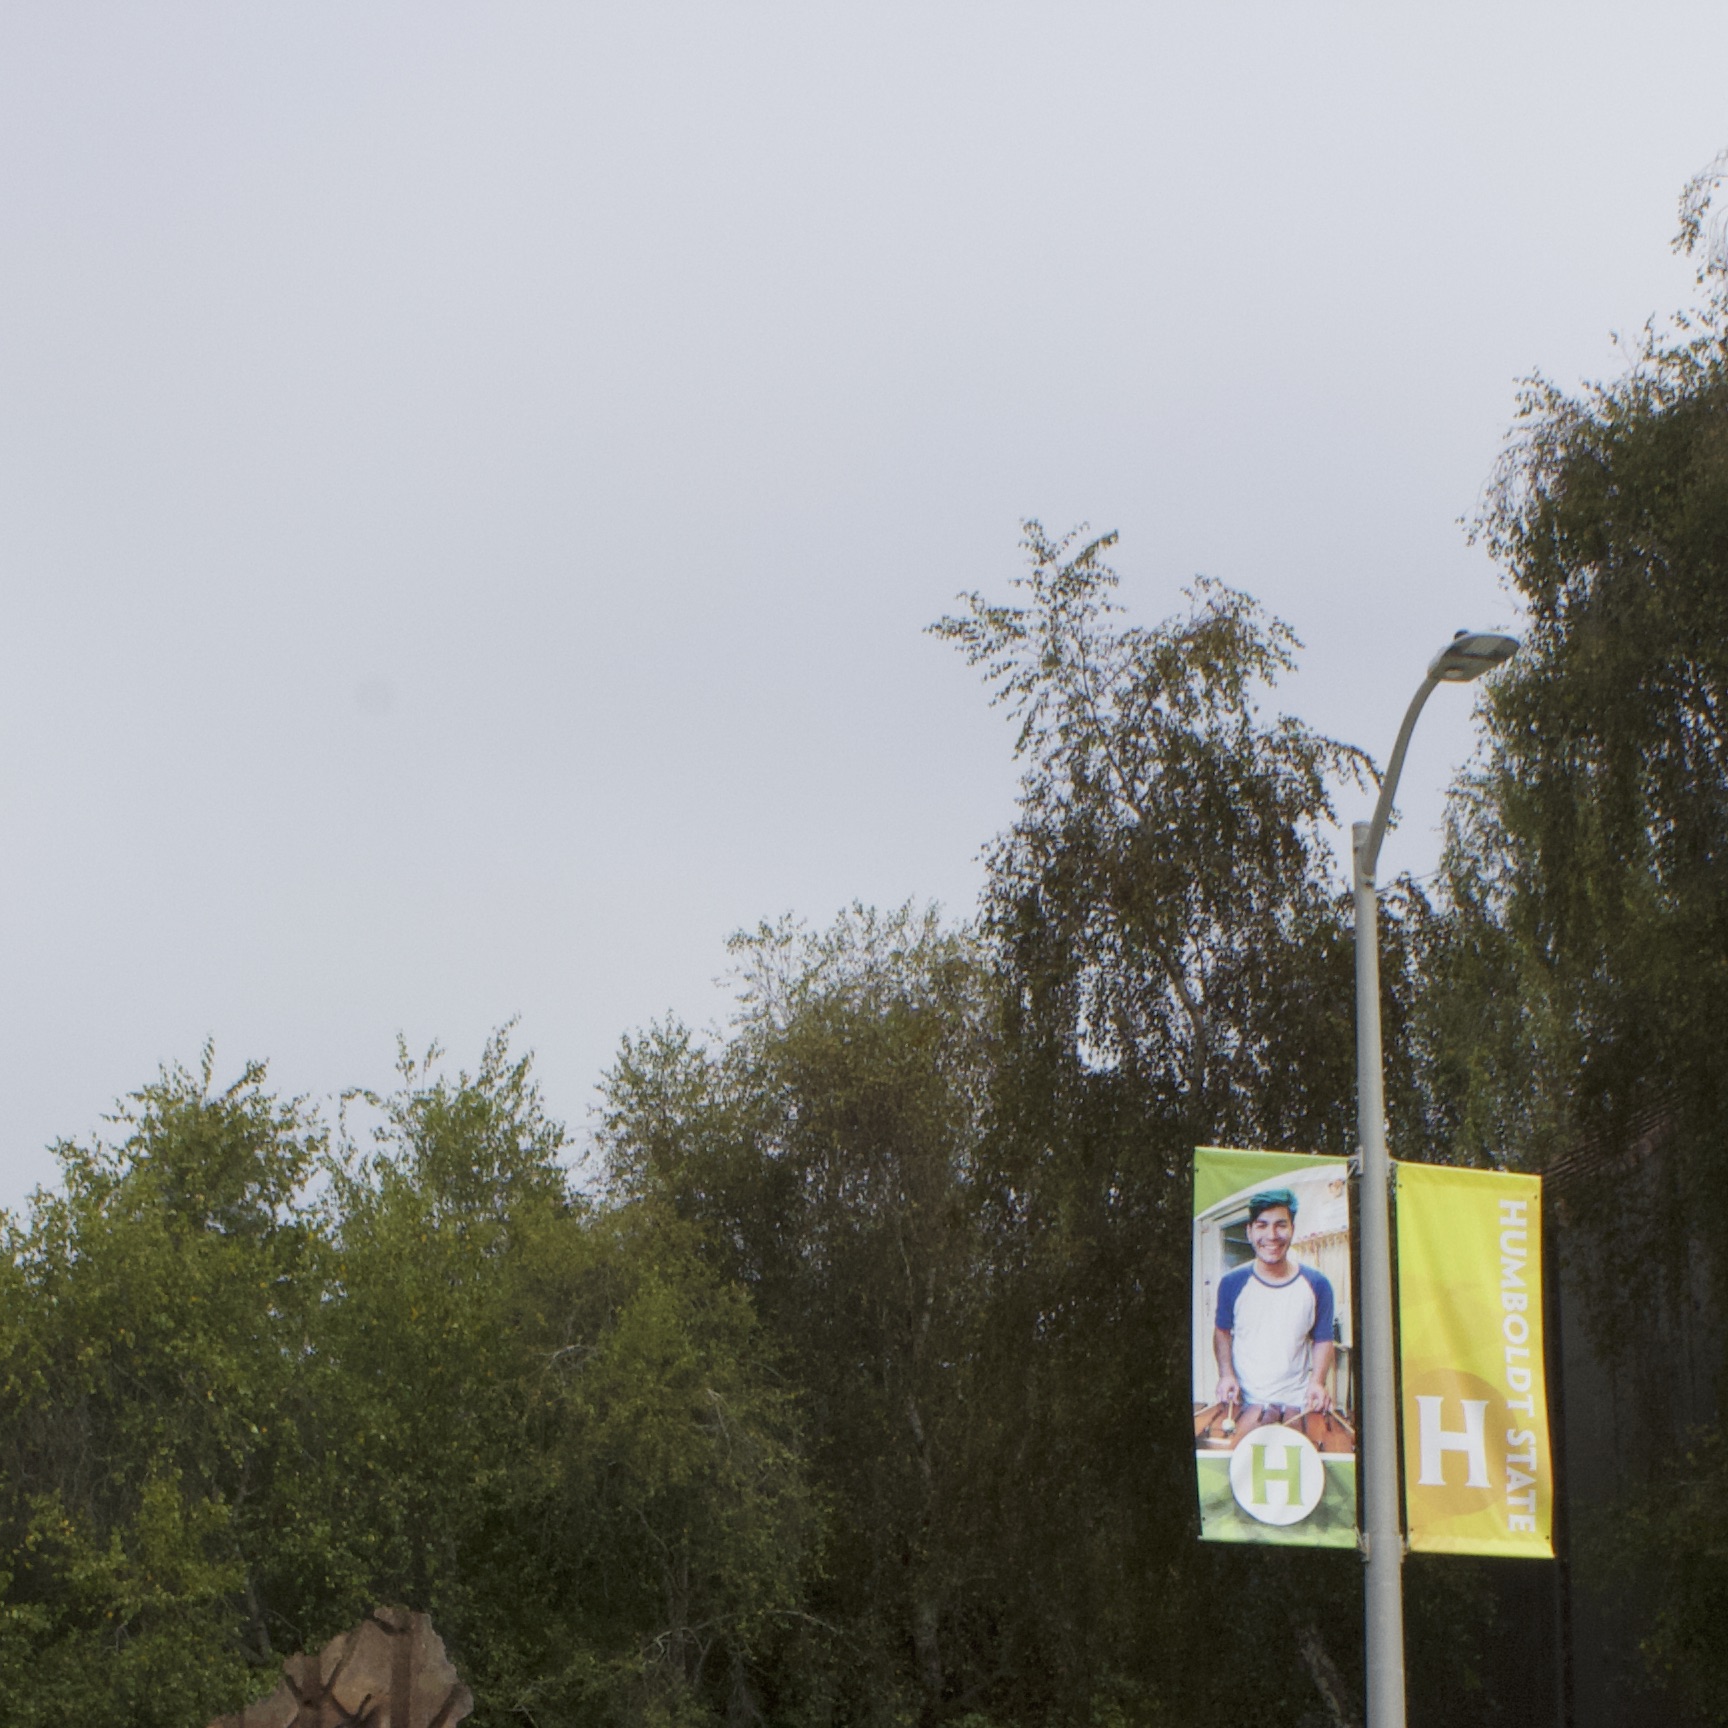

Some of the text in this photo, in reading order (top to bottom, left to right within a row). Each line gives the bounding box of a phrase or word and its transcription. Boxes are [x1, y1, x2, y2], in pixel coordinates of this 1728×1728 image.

[1497, 1199, 1537, 1534] HUMBOLDT STATE
[1250, 1442, 1304, 1507] H
[1415, 1395, 1492, 1489] H
